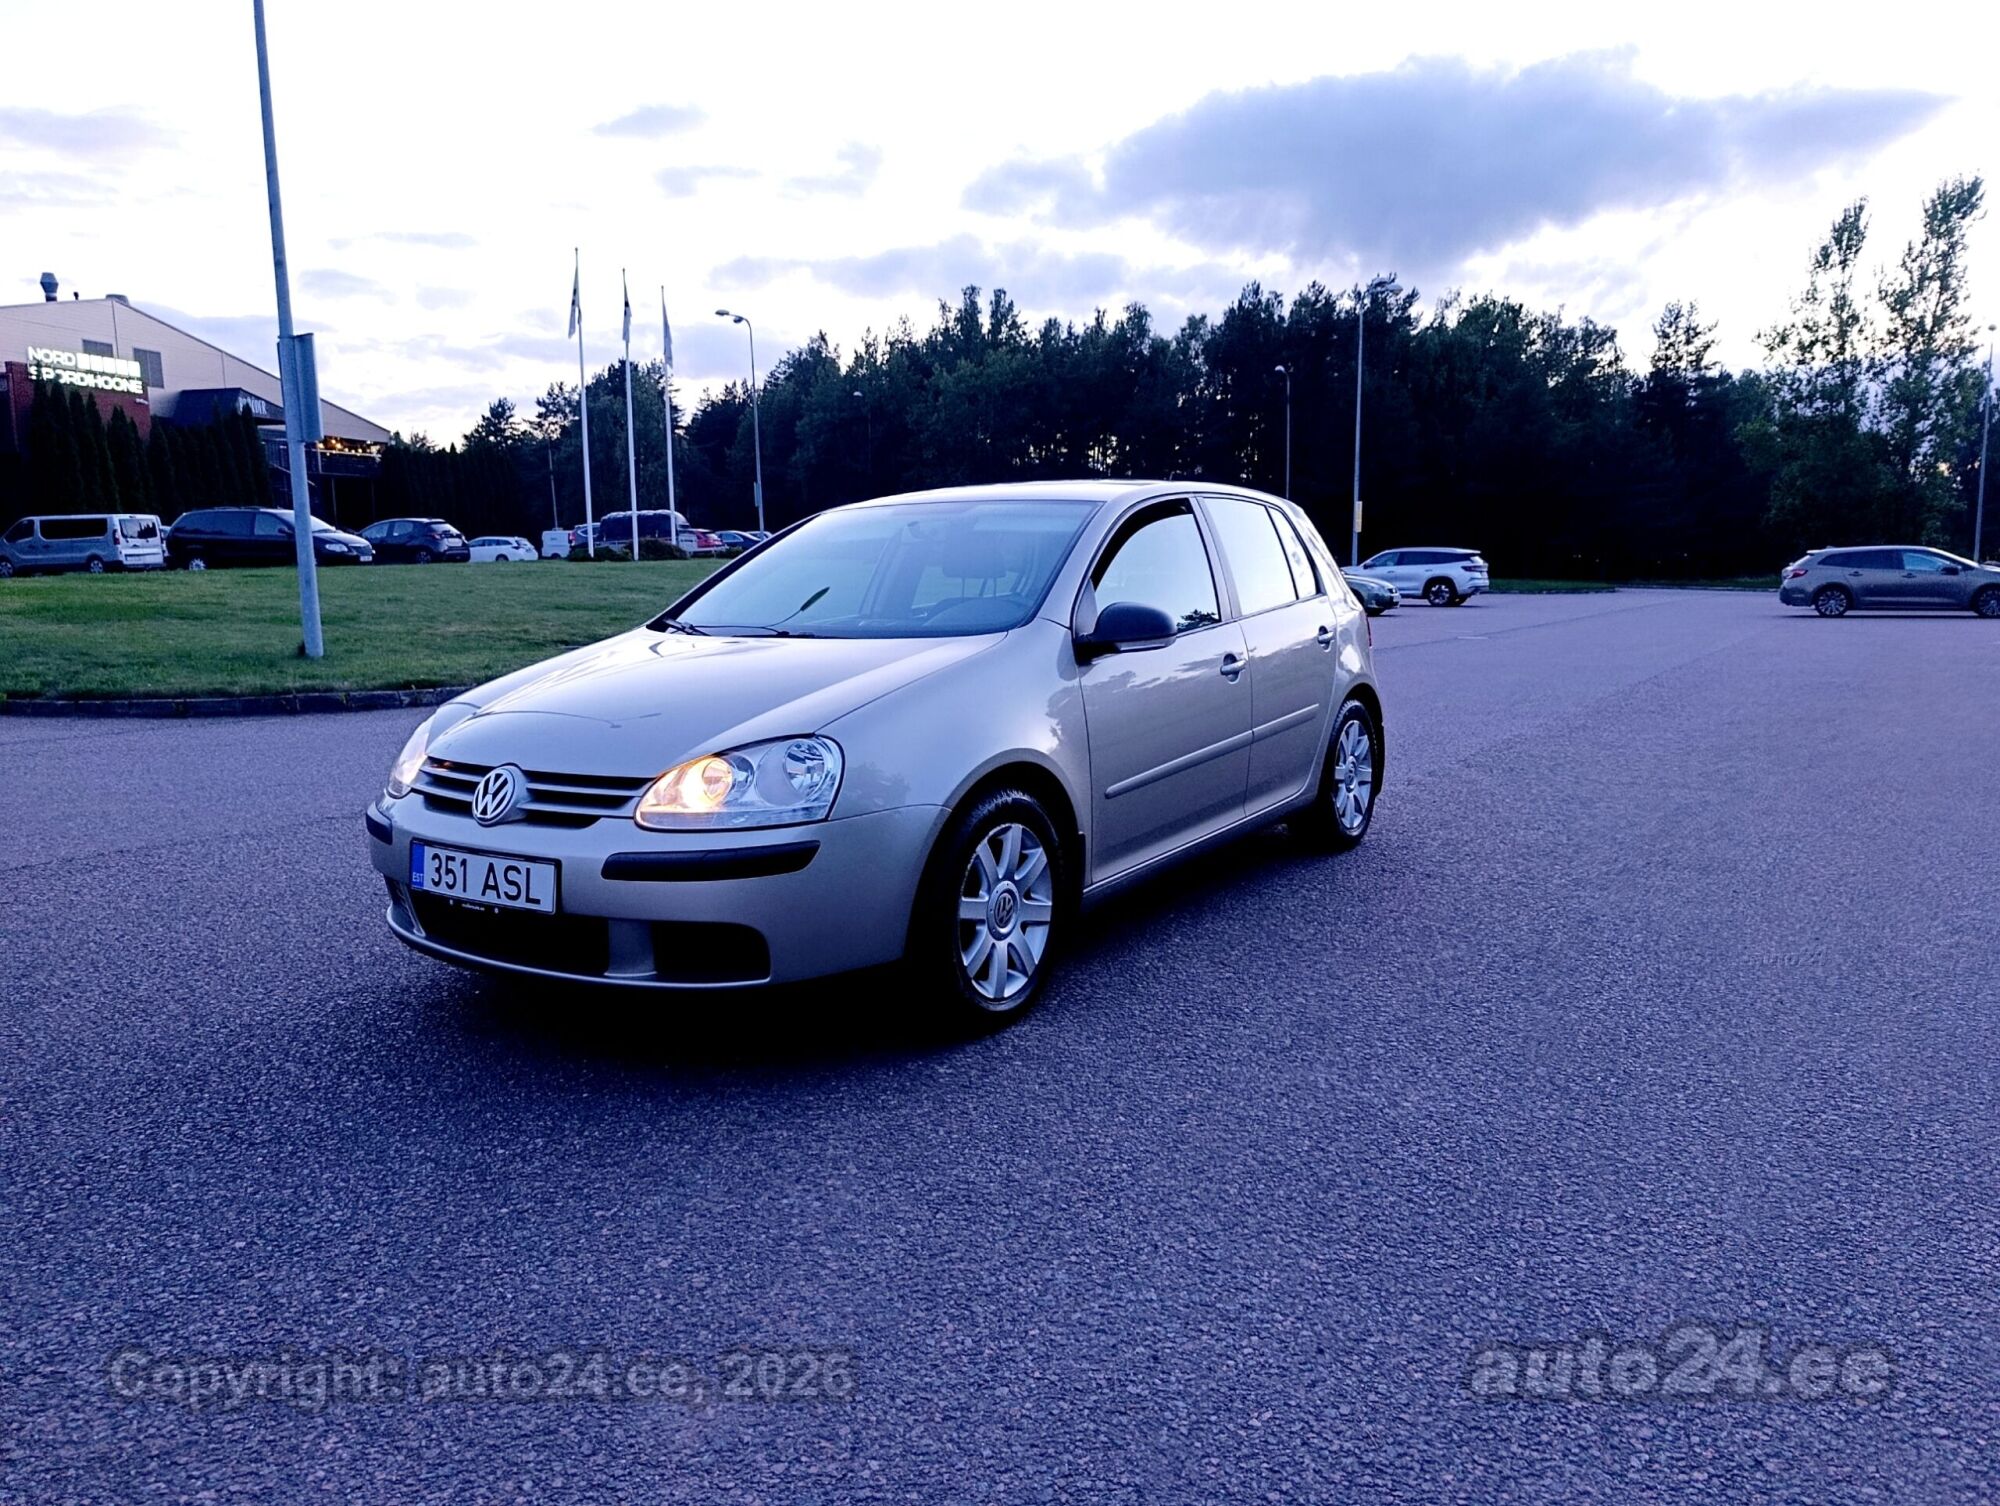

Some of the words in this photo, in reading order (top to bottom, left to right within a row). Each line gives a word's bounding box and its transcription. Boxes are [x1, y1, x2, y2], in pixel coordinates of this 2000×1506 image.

[27, 346, 76, 367] NORD
[412, 871, 424, 883] EST
[431, 852, 468, 893] 351
[481, 861, 541, 905] ASL
